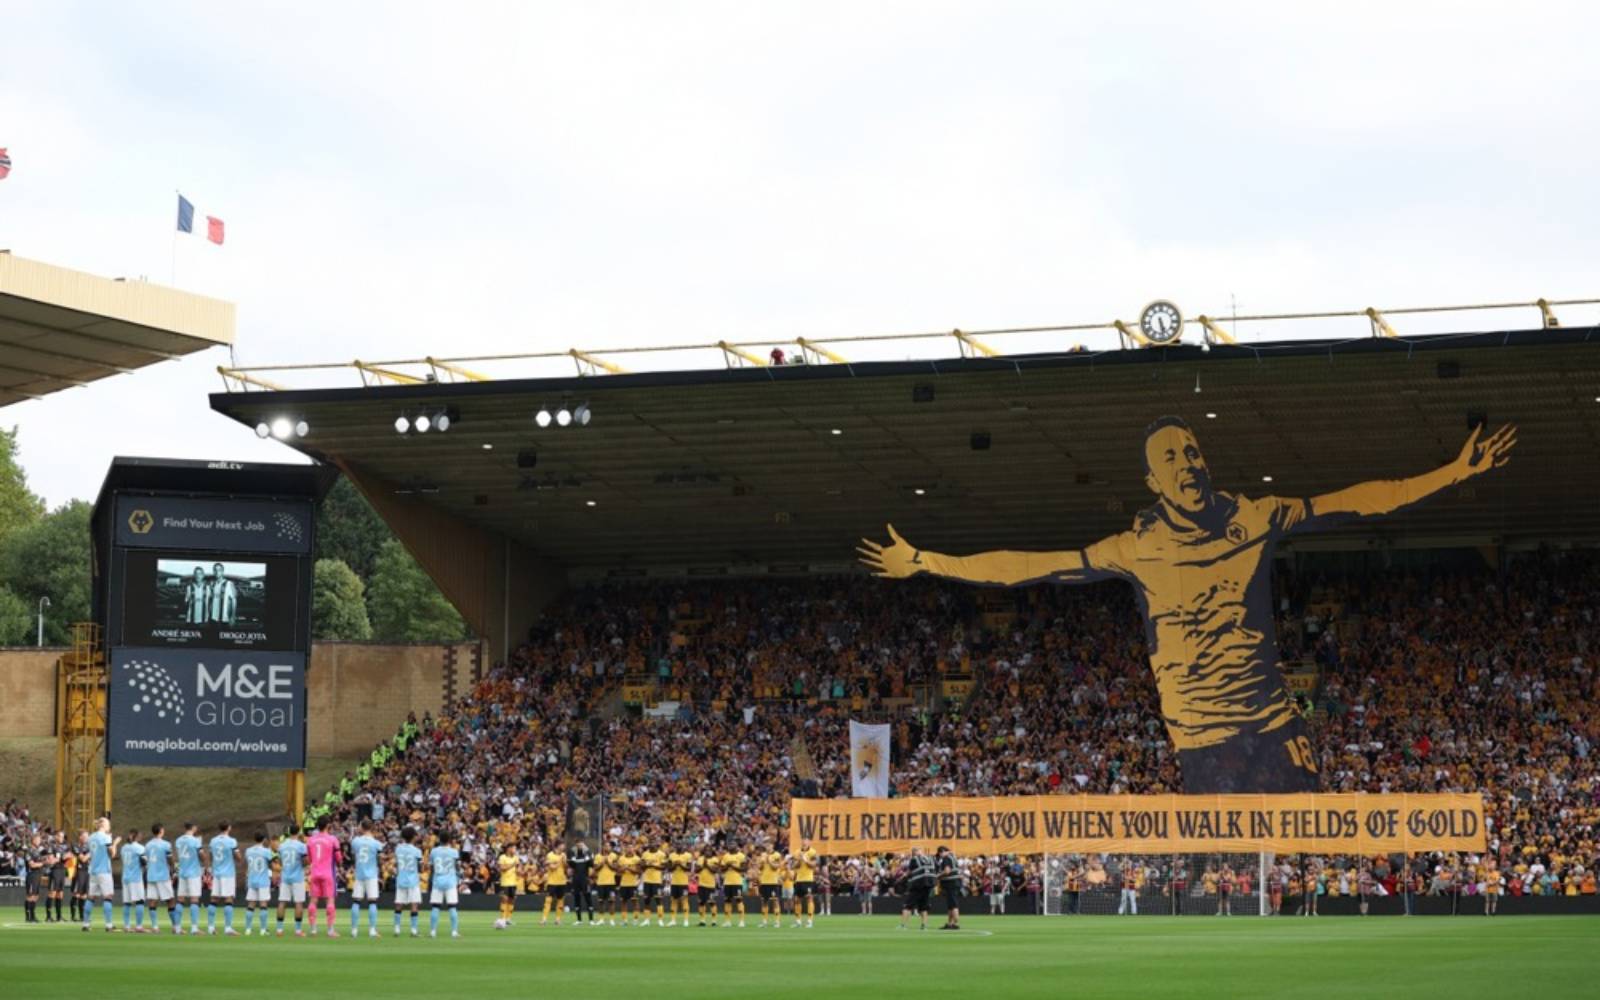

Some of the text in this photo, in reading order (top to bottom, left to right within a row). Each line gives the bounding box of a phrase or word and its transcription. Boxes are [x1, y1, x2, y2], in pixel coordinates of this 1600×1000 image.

[163, 517, 265, 531] Find Your Next Job
[151, 628, 202, 639] ANDRÉ SILVA
[219, 631, 267, 641] DIOGO JOTA
[196, 662, 294, 699] M&E
[196, 701, 294, 727] Global
[125, 737, 288, 753] mneglobal.com/wolves
[1284, 736, 1318, 774] 18
[797, 808, 1478, 841] WE'LL REMEMBER YOU WHEN YOU WALK IN FIELDS OF GOLD
[316, 843, 322, 859] 1
